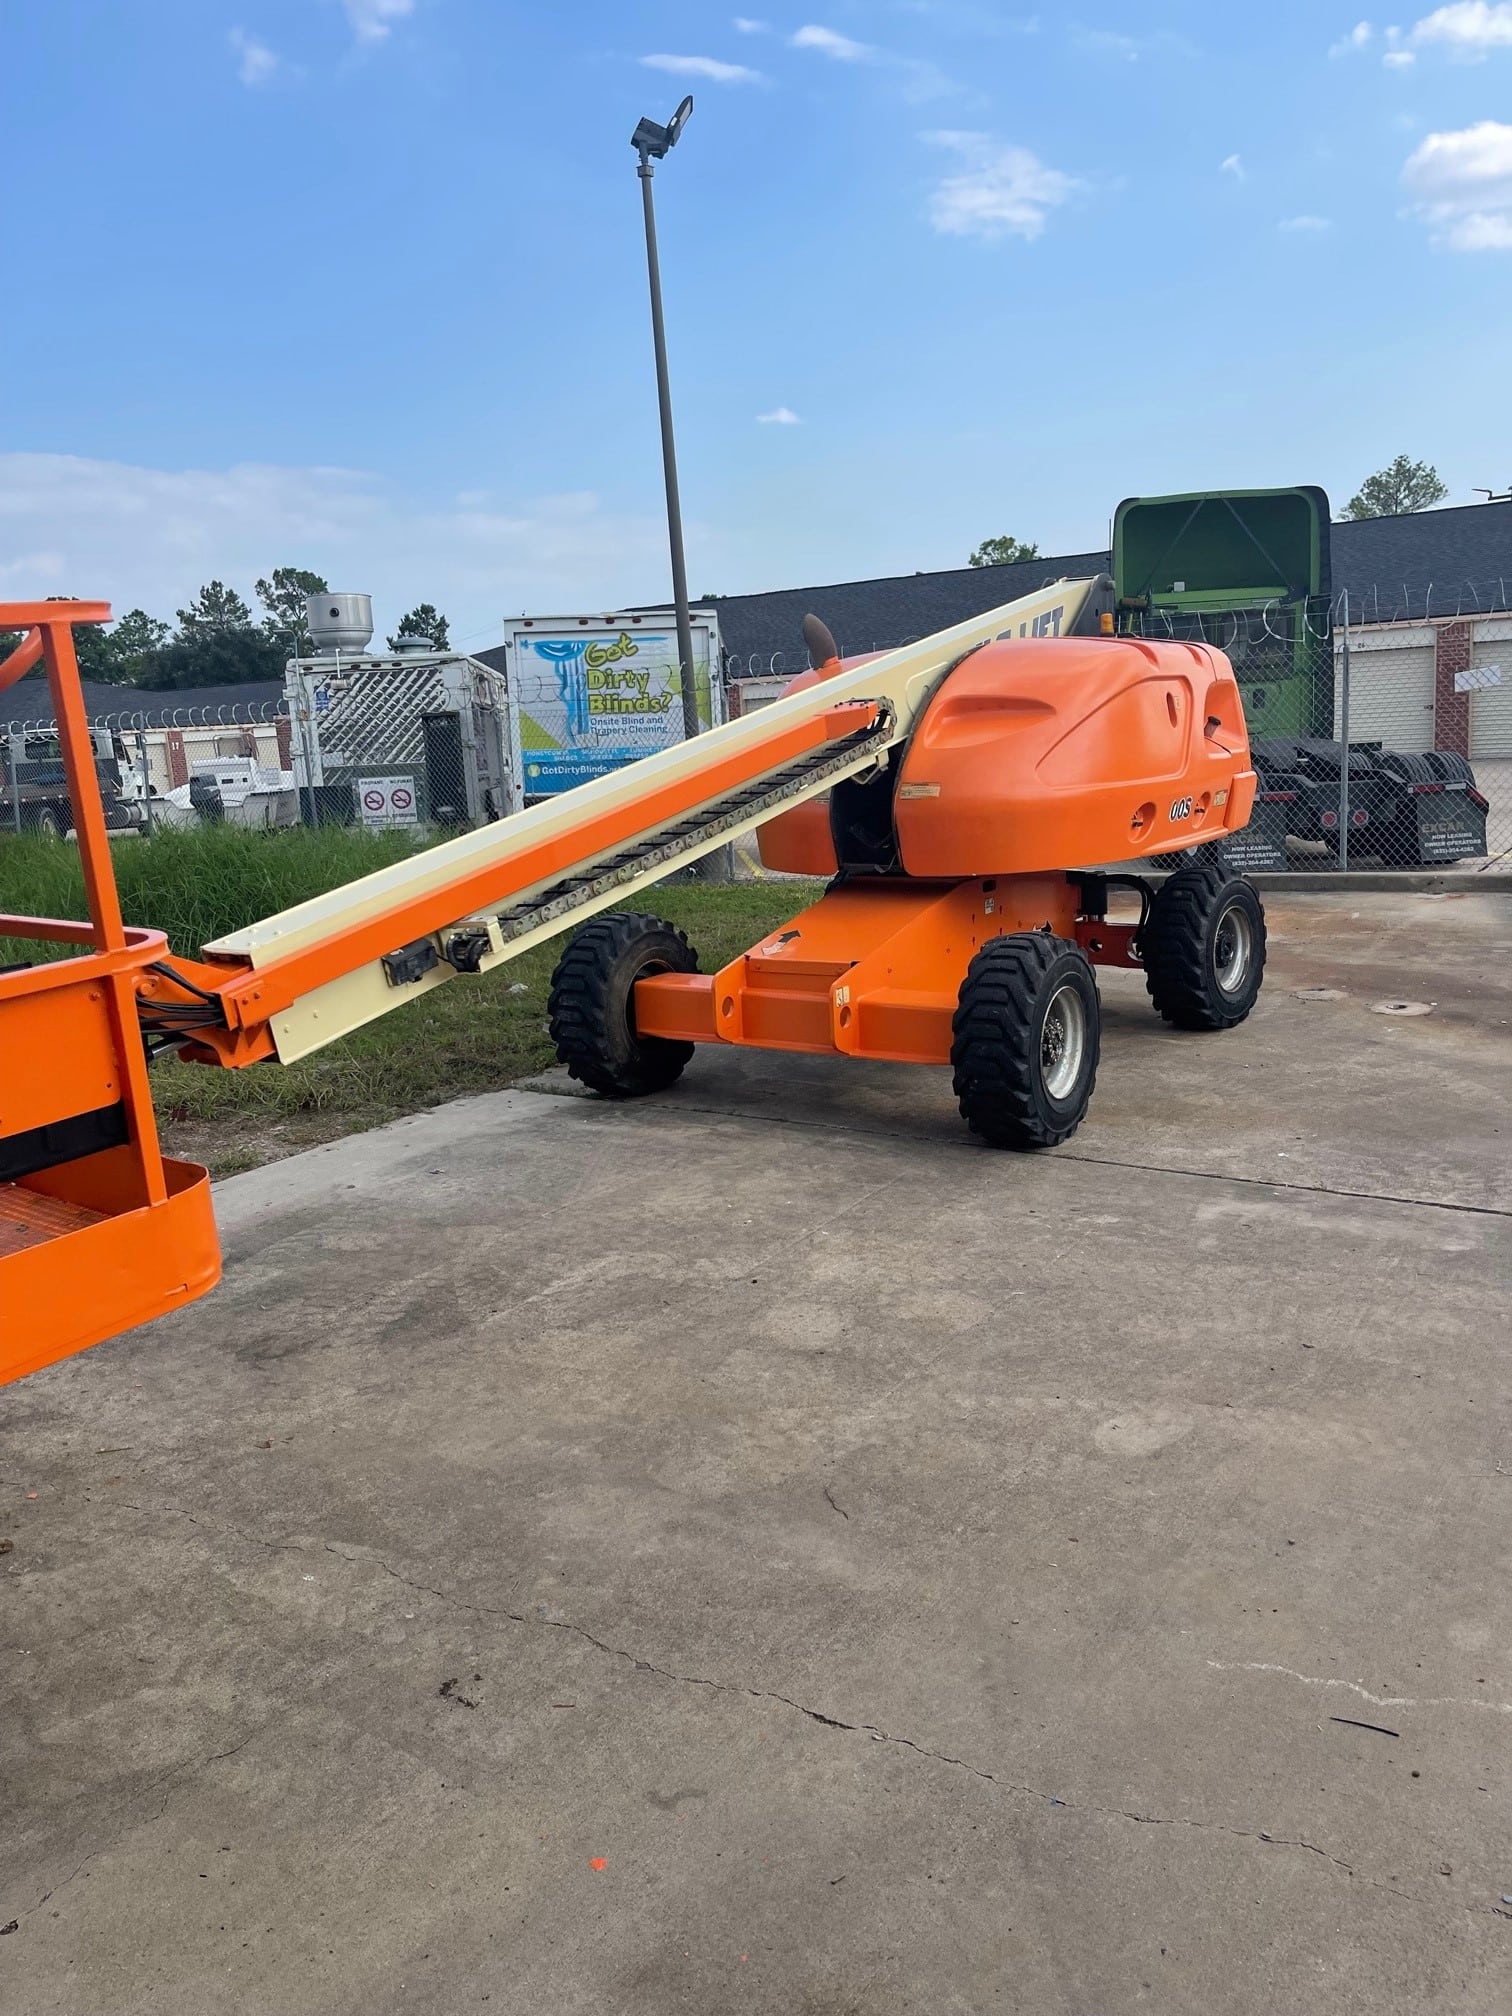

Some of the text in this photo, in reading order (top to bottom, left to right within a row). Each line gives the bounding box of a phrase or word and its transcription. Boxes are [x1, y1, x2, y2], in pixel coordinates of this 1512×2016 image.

[587, 668, 650, 695] Dirty
[588, 692, 673, 714] Blinds?
[590, 716, 664, 726] Onsite Blind and
[591, 725, 668, 735] Drapery Cleaning
[1446, 838, 1482, 846] OPERATORS
